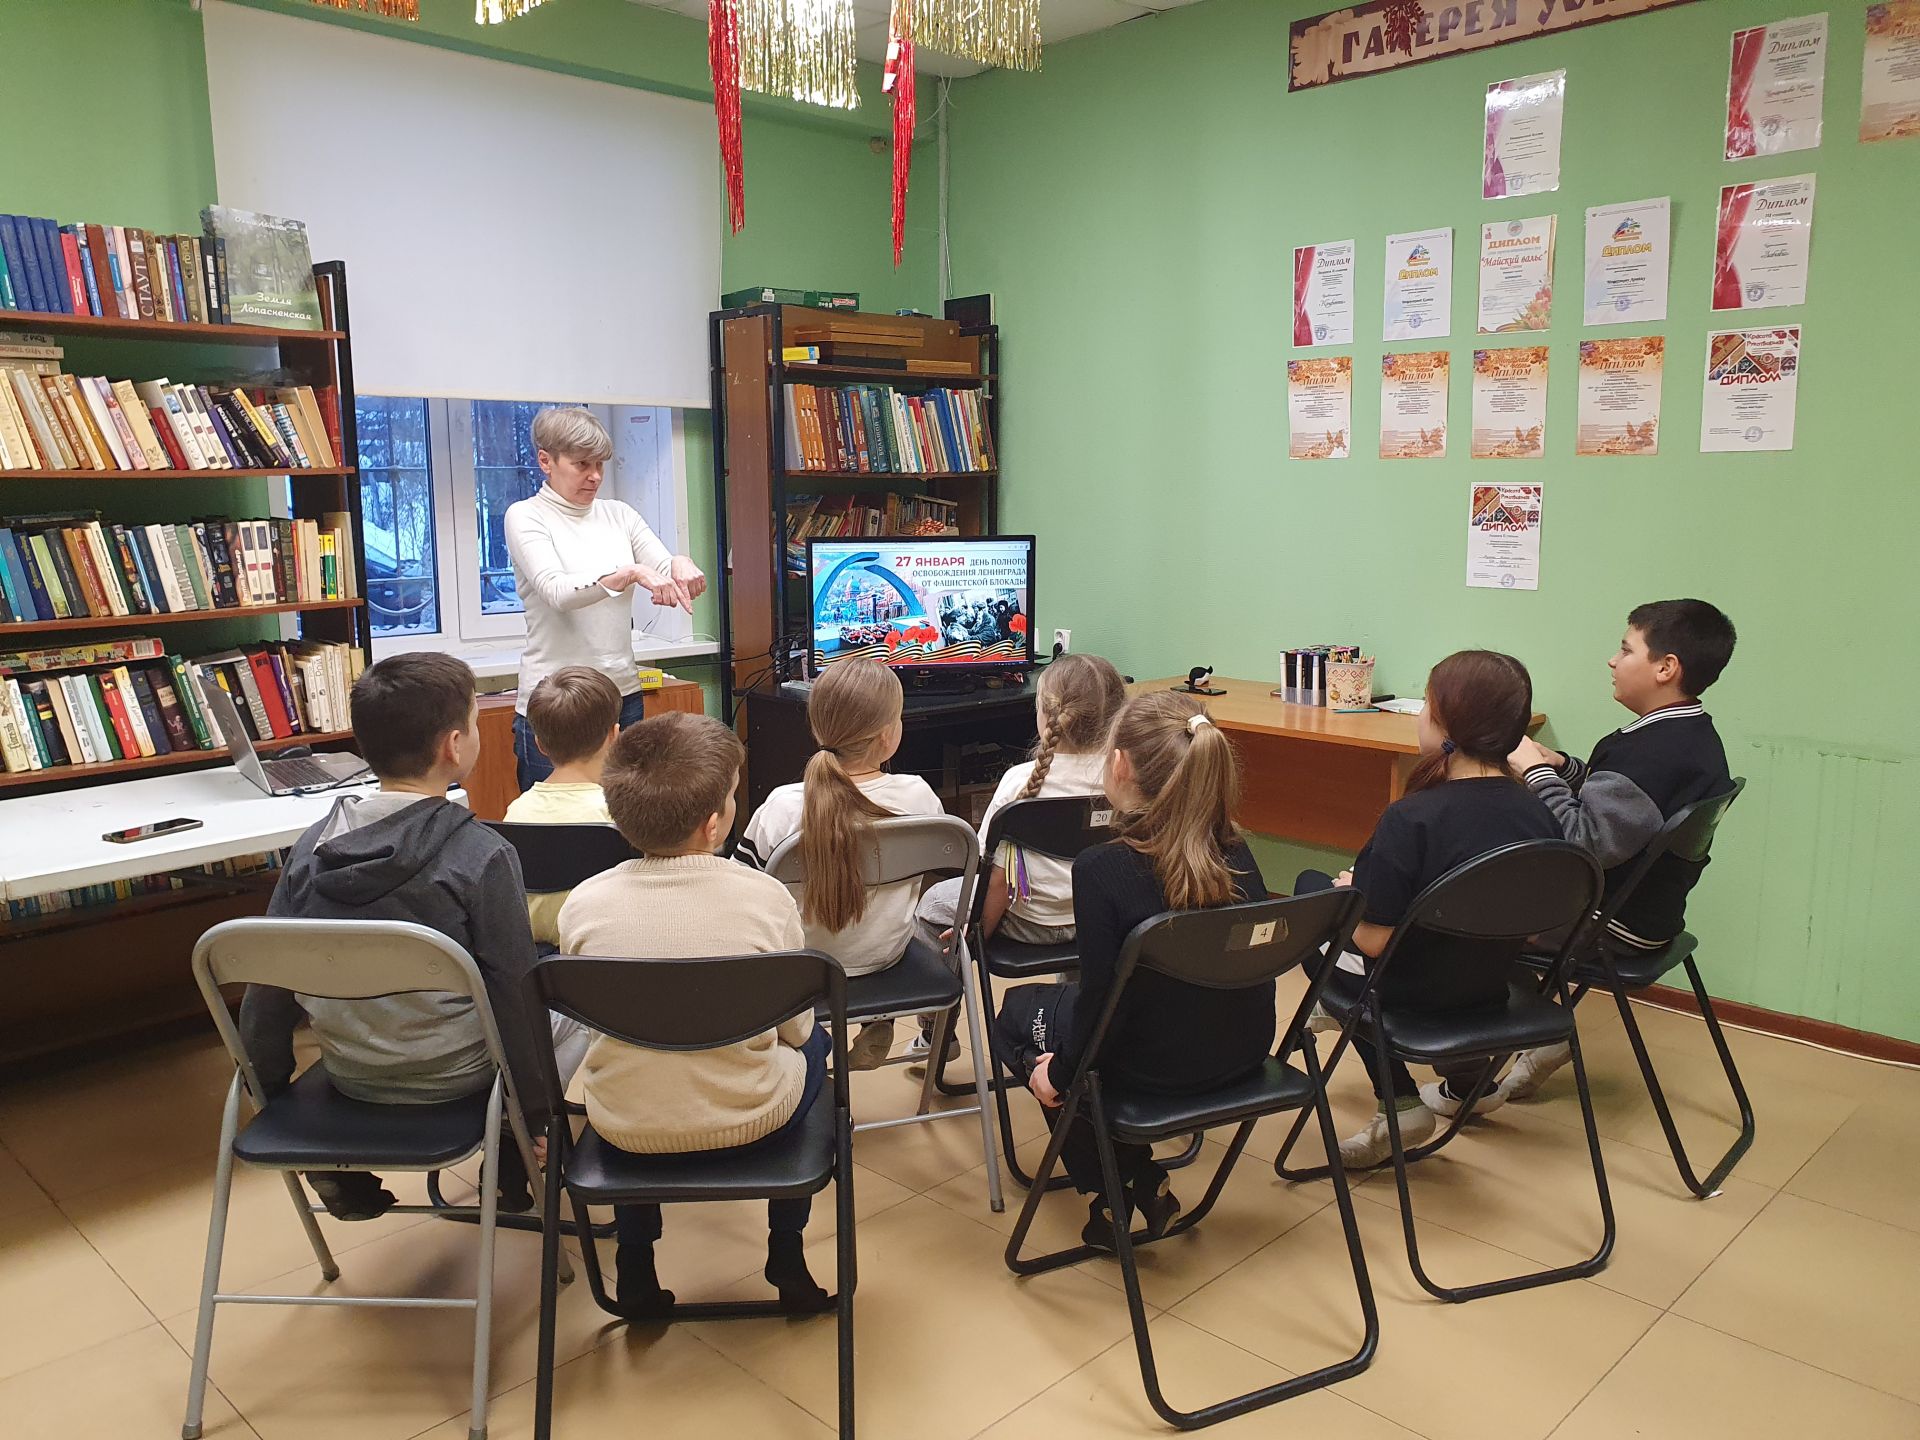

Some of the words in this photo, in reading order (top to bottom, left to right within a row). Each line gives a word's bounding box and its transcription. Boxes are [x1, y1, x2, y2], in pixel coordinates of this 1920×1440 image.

[1767, 36, 1821, 55] Диплом
[1755, 197, 1808, 211] Диплом
[1487, 236, 1540, 250] ДИПЛОМ
[134, 260, 154, 317] СТАУТ
[256, 291, 292, 305] Земля
[240, 303, 312, 320] Лопасненская
[1720, 372, 1781, 385] ДИПЛОМ
[1480, 522, 1528, 532] ДИПЛОМ
[895, 556, 911, 567] 27
[915, 556, 965, 567] ЯНВАРЯ
[969, 558, 989, 566] ДЕНЬ
[991, 557, 1026, 566] ПОЛНОГО
[912, 569, 976, 578] ОСВОБОЖДЕНИЯ
[977, 568, 1026, 576] ЛЕНИНГРАДА
[921, 579, 931, 587] ОТ
[933, 577, 988, 587] ФАШИСТСКОЙ
[989, 577, 1026, 586] БЛОКАДЫ
[1095, 813, 1108, 822] 20
[1260, 927, 1268, 937] 4
